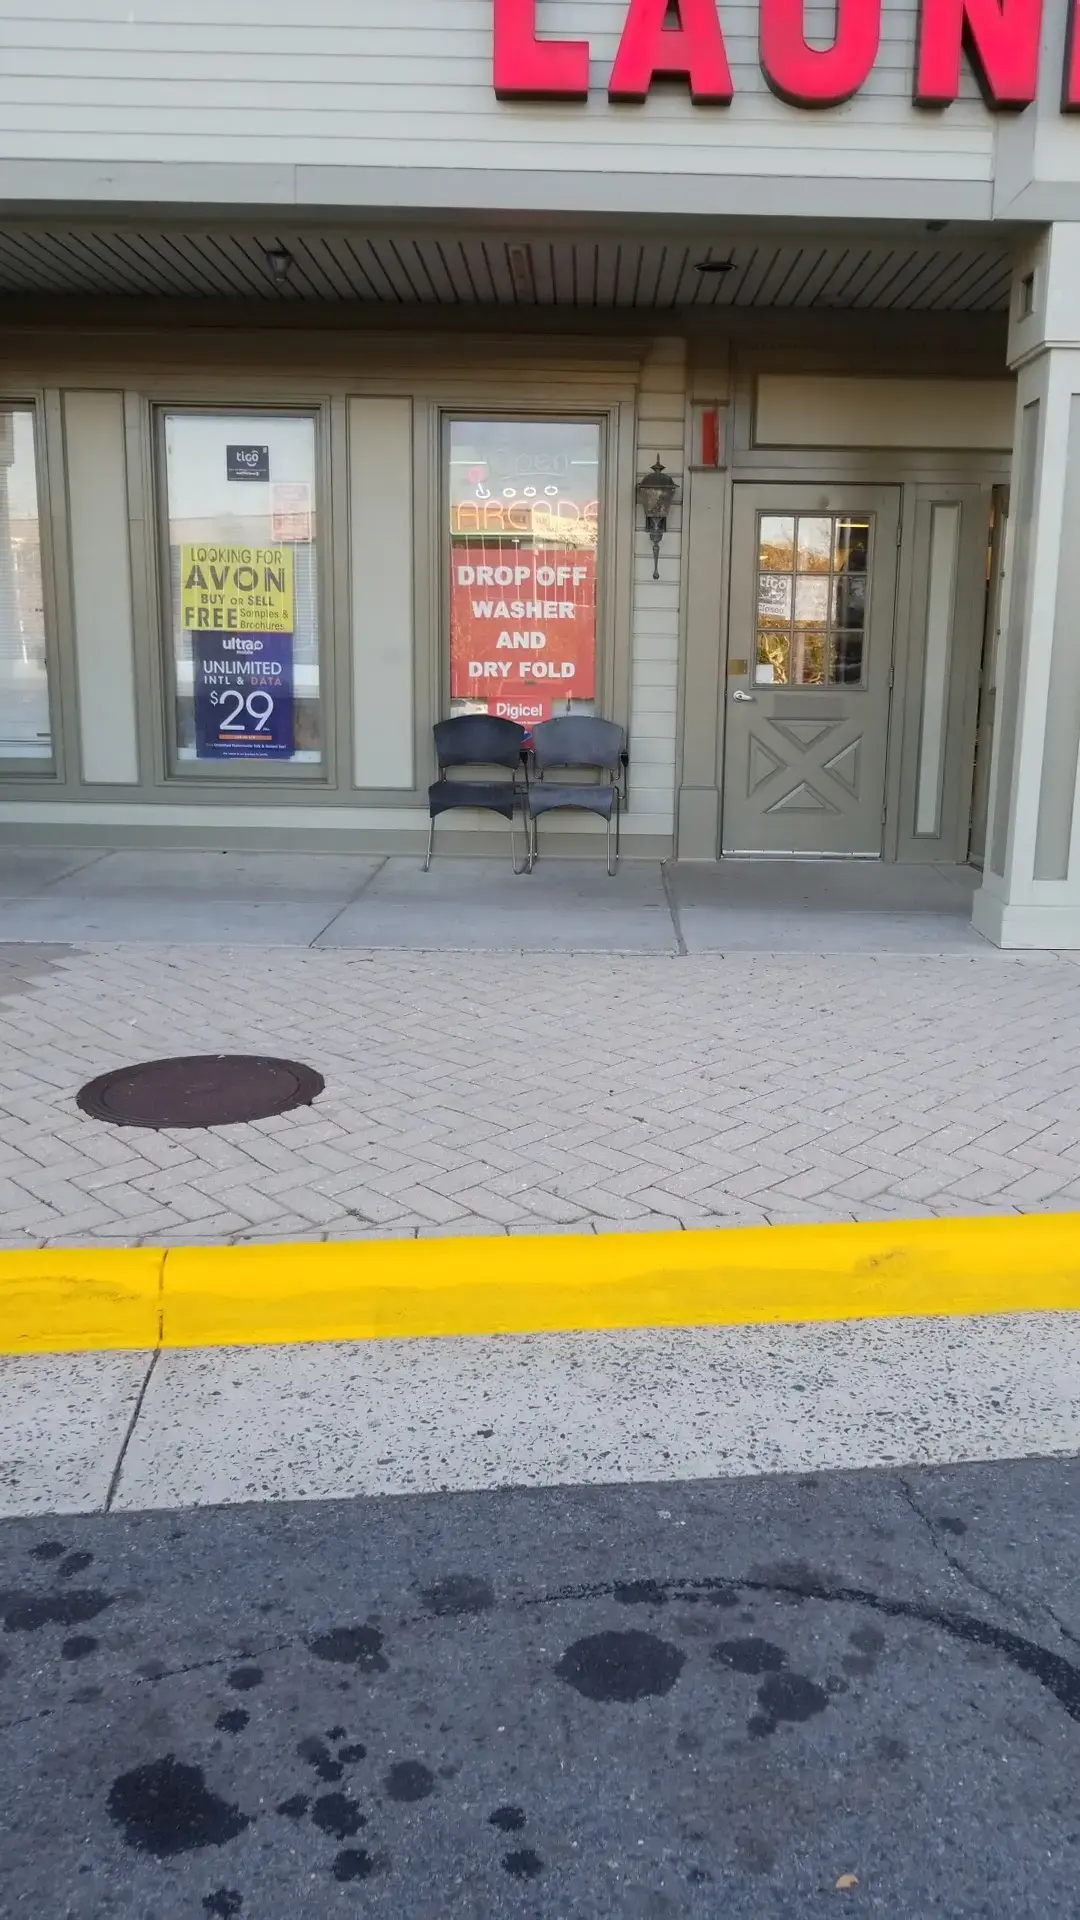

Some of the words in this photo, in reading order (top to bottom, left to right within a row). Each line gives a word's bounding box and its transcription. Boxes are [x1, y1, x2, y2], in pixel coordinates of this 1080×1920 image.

[493, 0, 1080, 112] LAUN
[191, 548, 251, 564] LOOKING
[256, 550, 282, 565] FOR
[184, 565, 285, 593] AVON
[458, 565, 531, 586] DROP
[536, 566, 587, 586] OFF
[200, 593, 225, 605] BUY
[230, 597, 244, 606] OR
[248, 596, 275, 606] SELL
[185, 607, 238, 628] FREE
[240, 608, 279, 619] Samples
[282, 609, 289, 619] &
[472, 601, 575, 619] WASHER
[240, 620, 284, 630] Brochures
[496, 631, 546, 649] AND
[203, 660, 282, 675] UNLIMITED
[468, 661, 512, 678] DRY
[519, 662, 575, 678] FOLD
[204, 675, 231, 685] INTL
[236, 676, 245, 685] &
[250, 676, 282, 686] DATA
[210, 690, 274, 731] $29
[496, 703, 543, 719] Digicel
